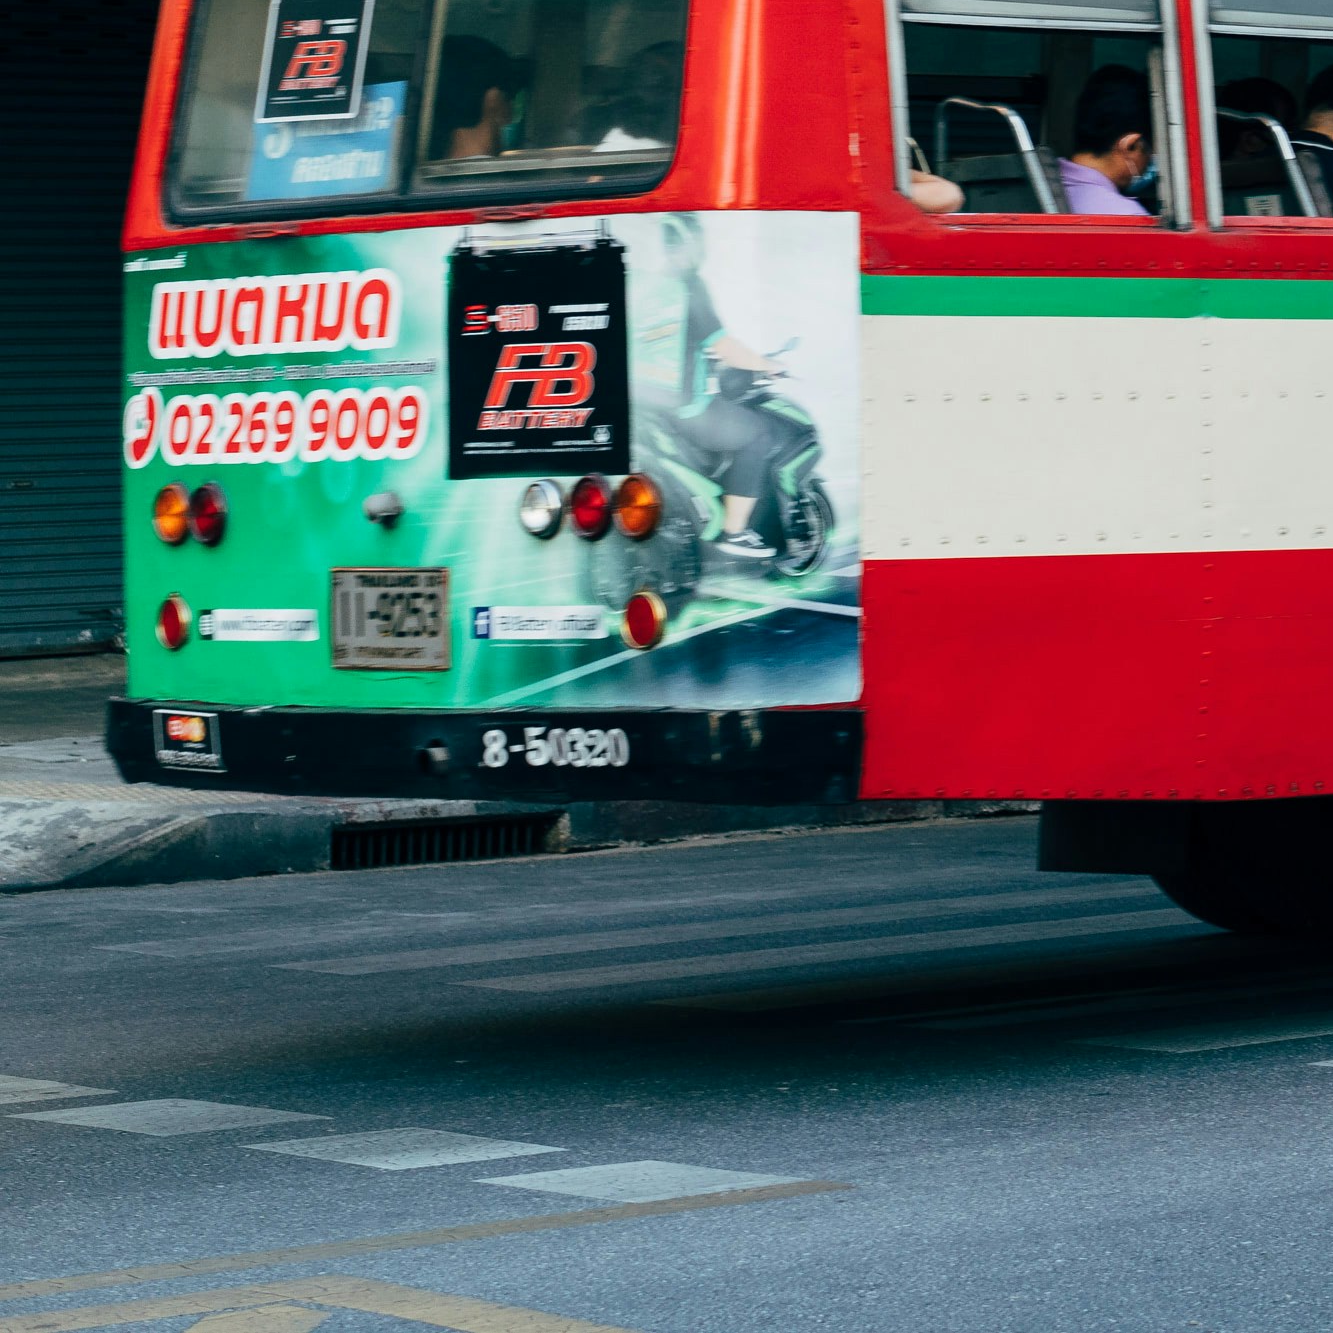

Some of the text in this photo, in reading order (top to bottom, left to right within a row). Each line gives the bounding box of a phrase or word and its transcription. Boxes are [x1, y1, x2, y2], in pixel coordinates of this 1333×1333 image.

[282, 39, 348, 78] FB
[155, 276, 394, 351] แบตหมด
[483, 341, 597, 409] FB
[169, 395, 420, 455] 02 269 9009
[476, 408, 595, 430] BATTERY
[340, 591, 440, 637] 11-9253
[481, 727, 630, 768] 8-50320
